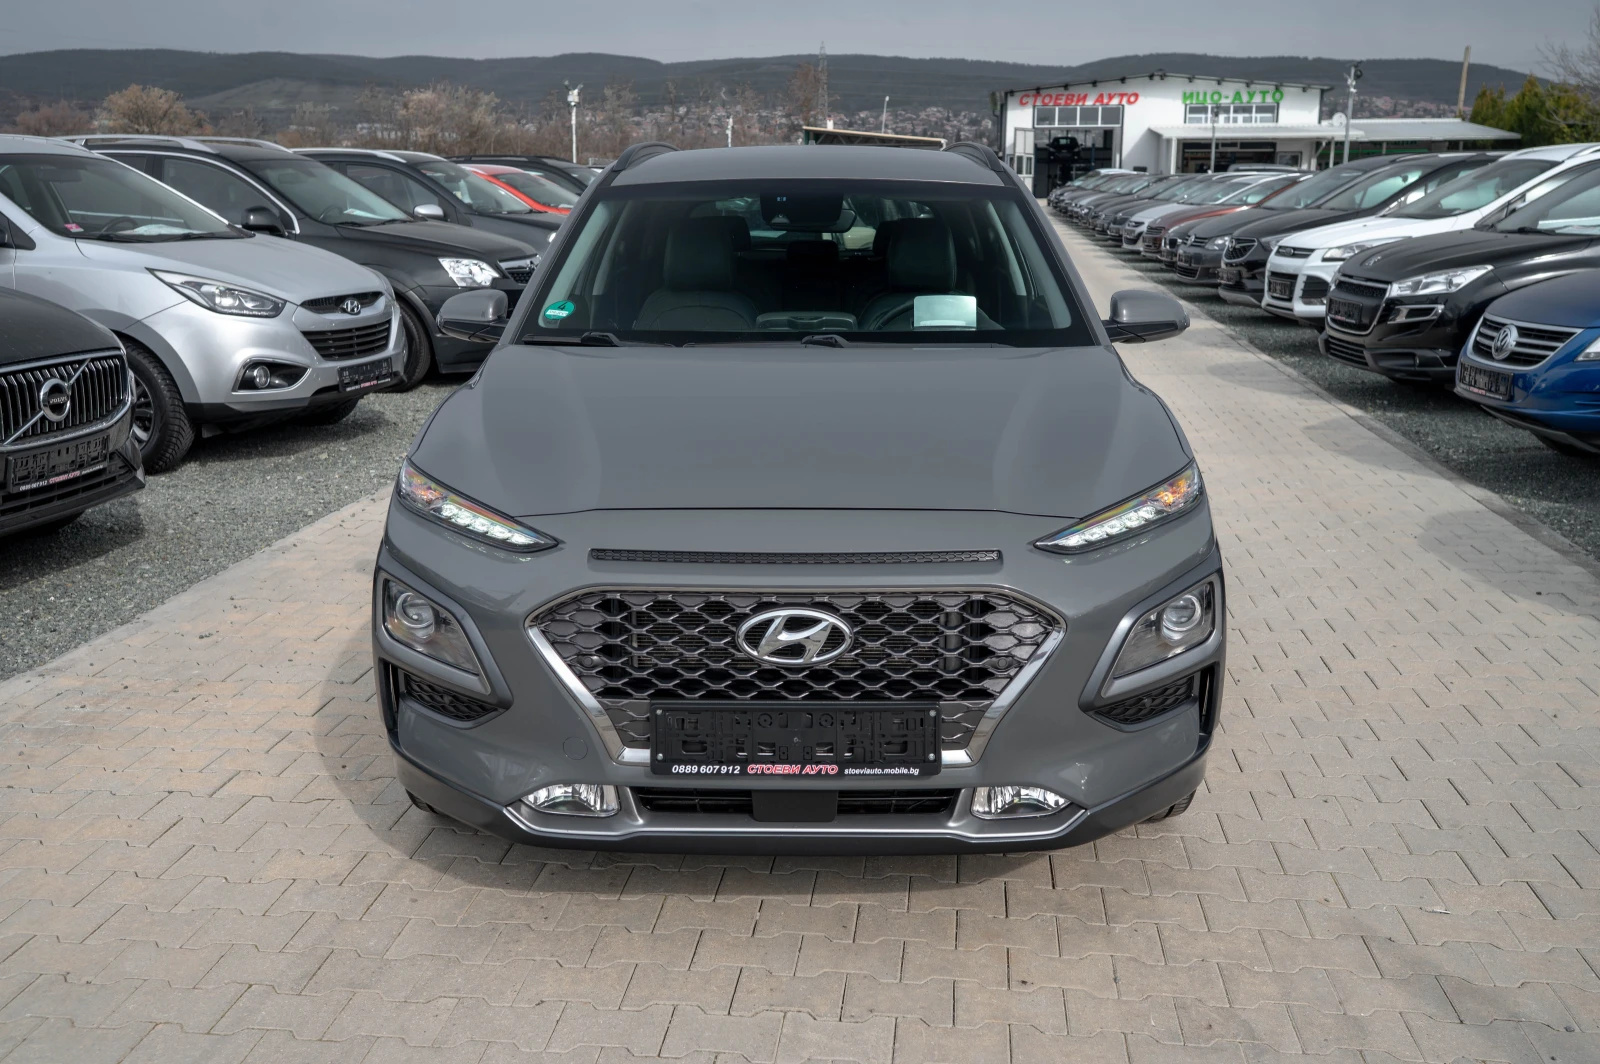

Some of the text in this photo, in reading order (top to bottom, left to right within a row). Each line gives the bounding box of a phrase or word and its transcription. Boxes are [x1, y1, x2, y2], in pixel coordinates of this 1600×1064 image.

[1019, 91, 1139, 106] СТОЕВИ АУТО
[1182, 89, 1284, 105] ИЦО-АУТО
[672, 764, 919, 775] 0889 607 912 СТОЕВИ АУТО stoeviauto.mobile.bg
